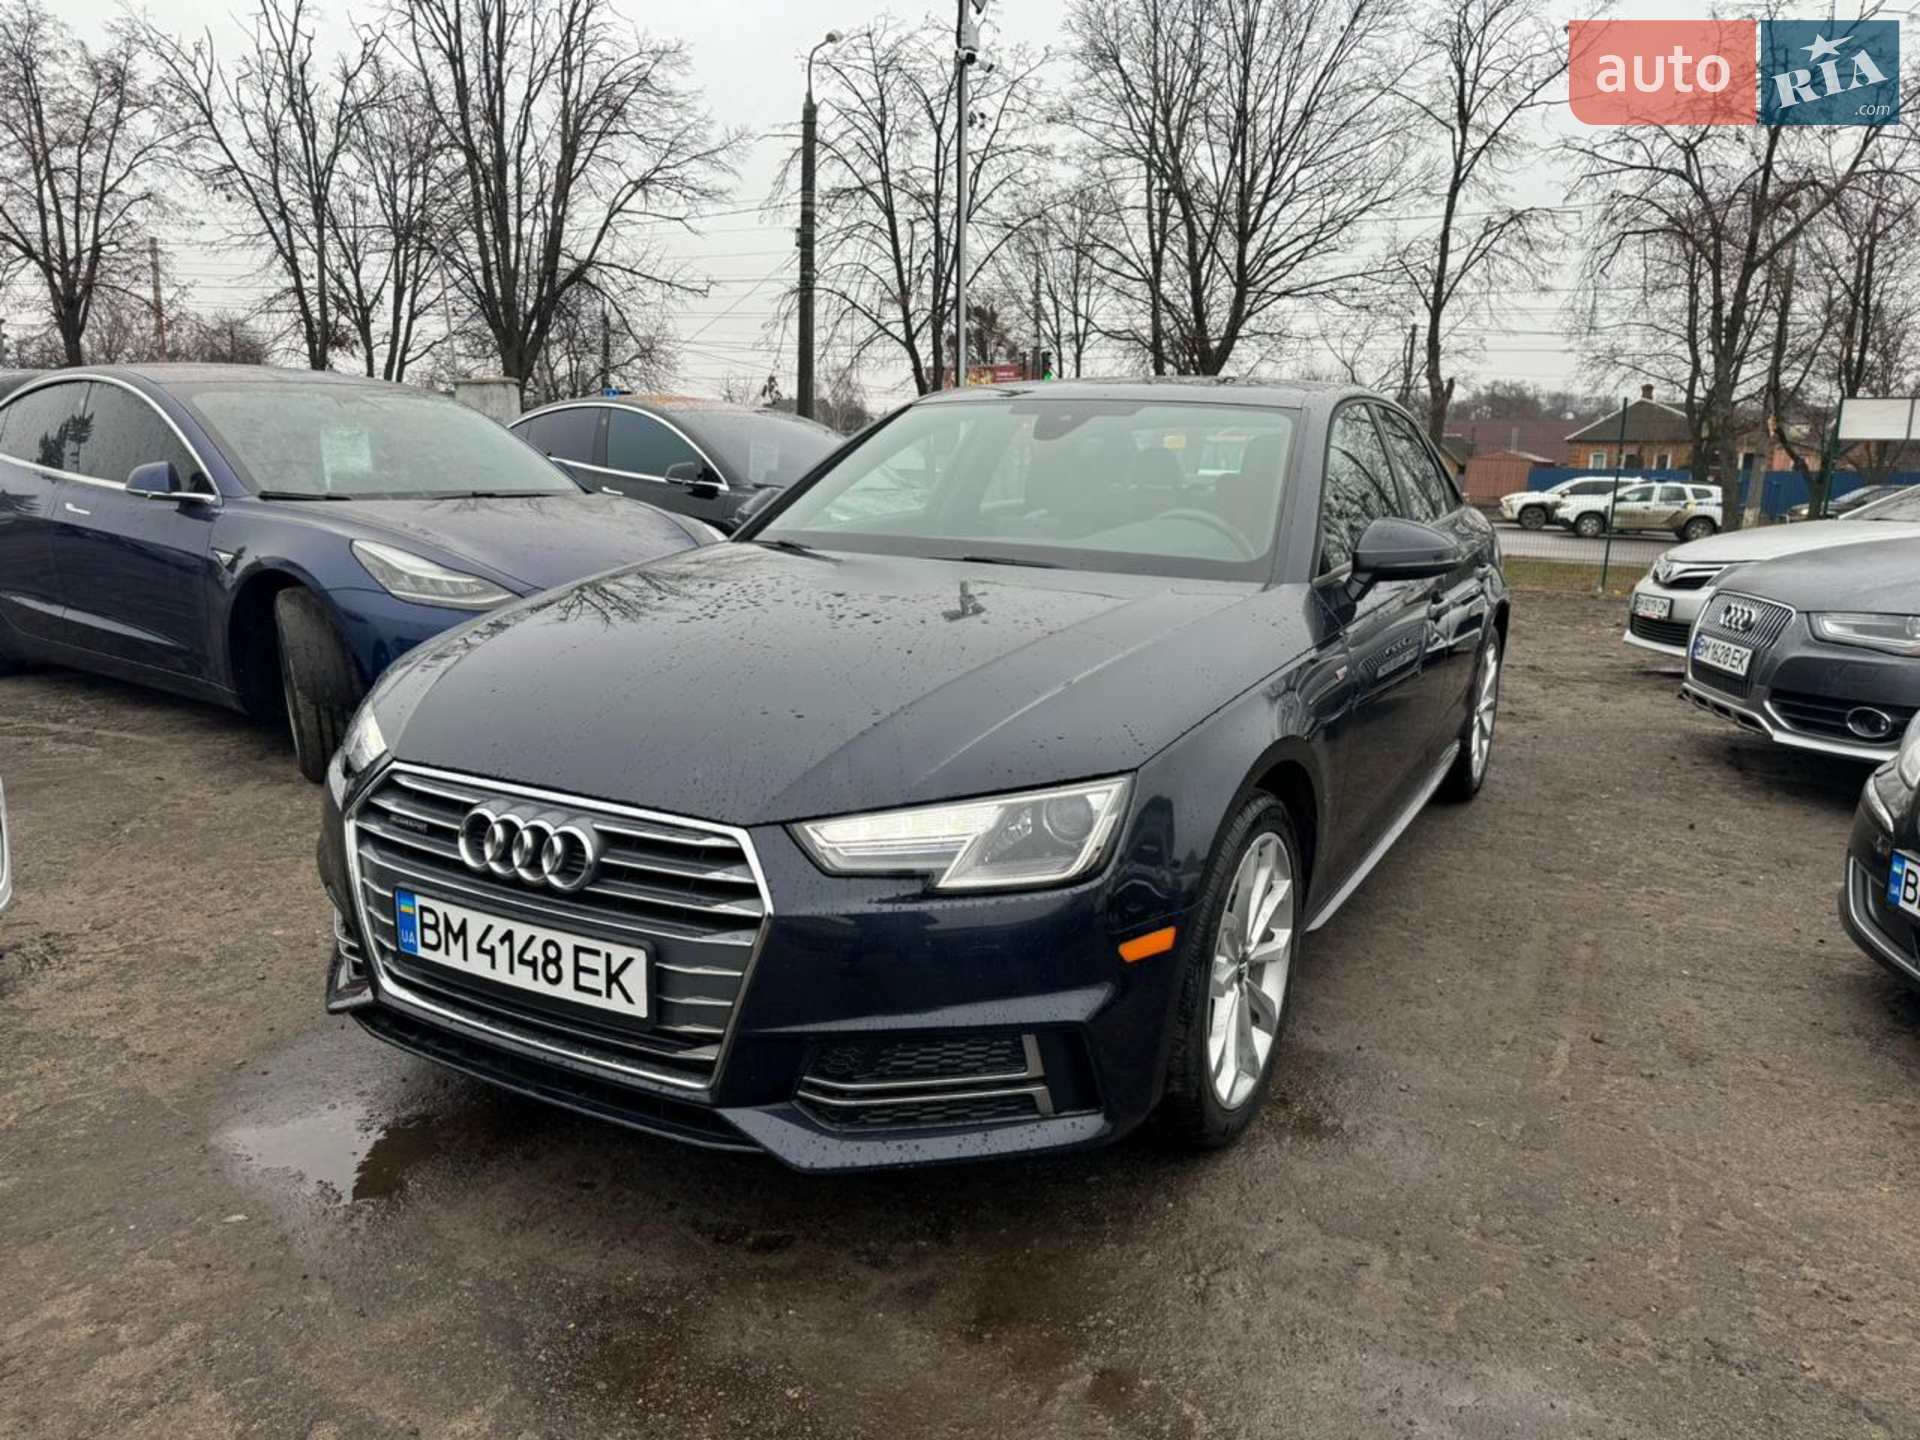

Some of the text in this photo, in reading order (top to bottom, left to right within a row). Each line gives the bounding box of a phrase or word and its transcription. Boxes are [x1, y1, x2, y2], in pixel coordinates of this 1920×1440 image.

[1729, 648, 1750, 672] EK
[1902, 867, 1920, 909] B
[401, 904, 636, 1006] UA BM 4148 EK
